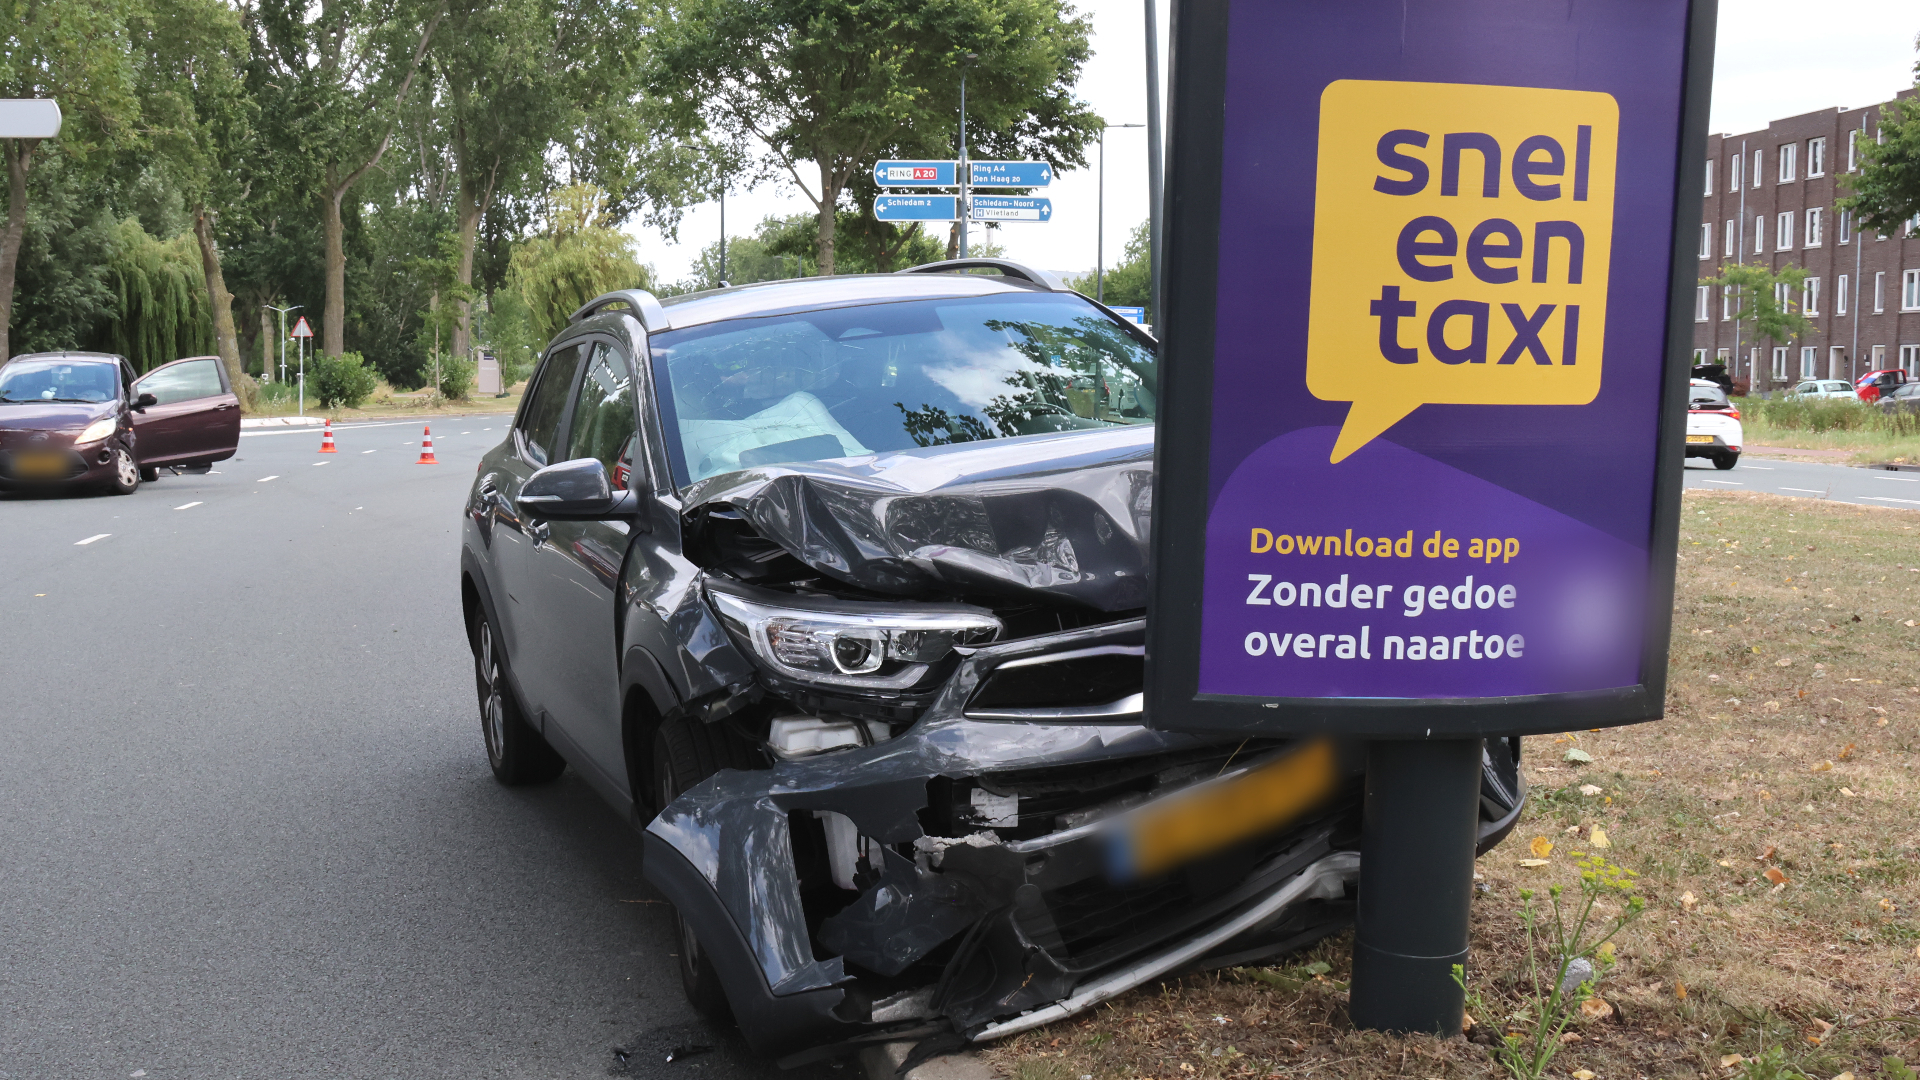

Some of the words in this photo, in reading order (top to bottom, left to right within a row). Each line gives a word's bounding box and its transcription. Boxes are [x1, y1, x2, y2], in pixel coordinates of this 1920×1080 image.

[889, 170, 912, 178] RING
[973, 165, 992, 174] Ring
[973, 175, 989, 183] Den
[990, 175, 1011, 184] Haag
[1373, 125, 1592, 202] snel
[985, 209, 1019, 217] Vlietland
[1396, 215, 1586, 285] een
[1369, 284, 1581, 366] taxi
[1249, 527, 1414, 558] Download
[1422, 529, 1460, 559] de
[1467, 535, 1521, 564] app
[1245, 573, 1393, 609] Zonder
[1403, 575, 1517, 617] gedoe
[1243, 625, 1371, 660] overal
[1382, 630, 1526, 660] naartoe
